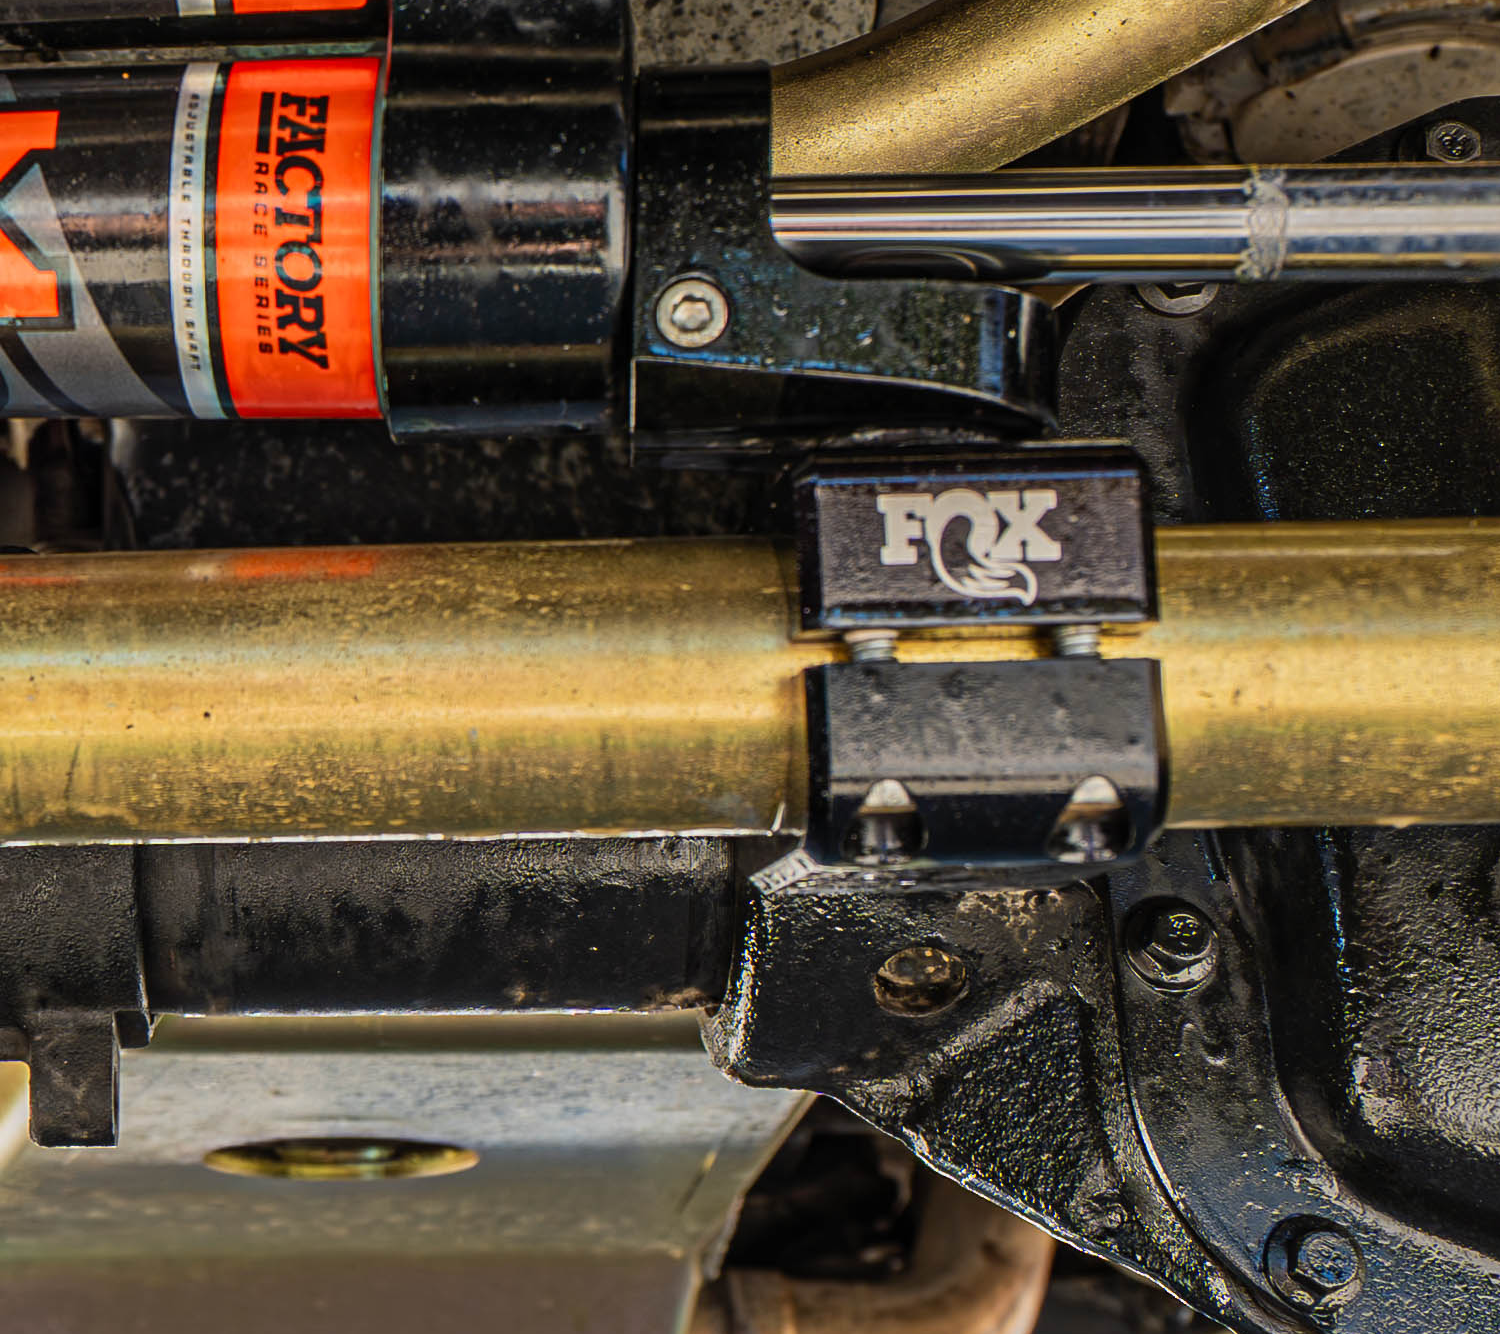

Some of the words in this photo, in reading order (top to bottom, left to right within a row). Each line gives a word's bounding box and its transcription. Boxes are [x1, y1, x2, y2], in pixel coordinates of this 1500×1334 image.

[180, 92, 202, 203] ADJUSTABLE
[253, 161, 271, 237] RACE
[274, 91, 330, 370] FACTORY
[183, 319, 202, 373] SHAFT
[253, 254, 274, 355] SERIES
[876, 487, 1063, 607] FOX
